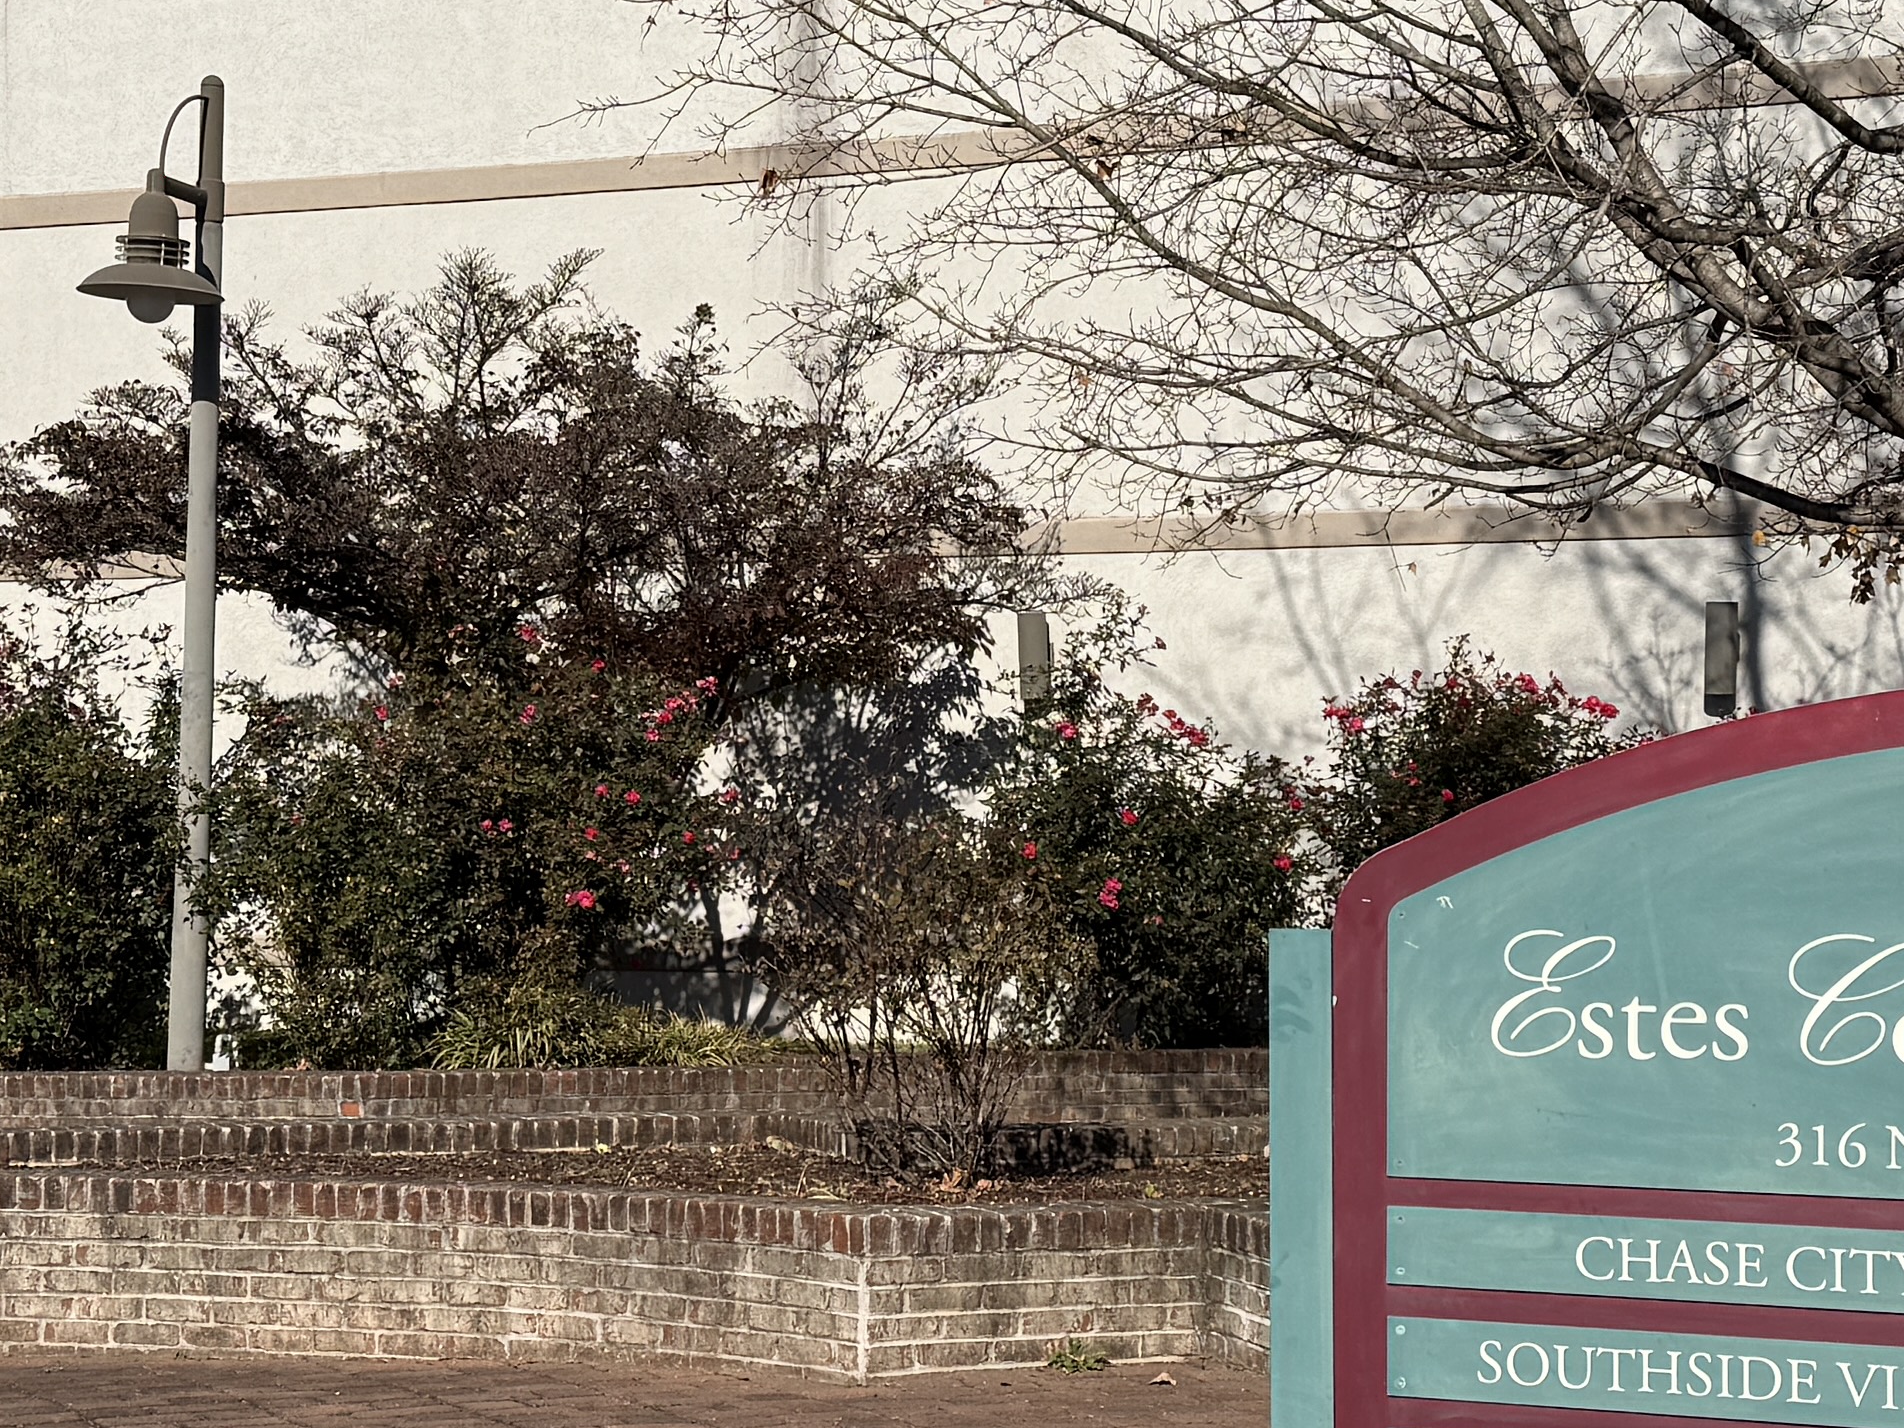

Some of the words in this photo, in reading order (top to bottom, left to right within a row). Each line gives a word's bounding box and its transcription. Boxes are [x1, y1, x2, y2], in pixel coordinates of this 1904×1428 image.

[1490, 929, 1749, 1061] Estes
[1774, 1122, 1867, 1168] 316
[1575, 1236, 1768, 1288] CHASE
[1476, 1340, 1821, 1404] SOUTHSIDE
